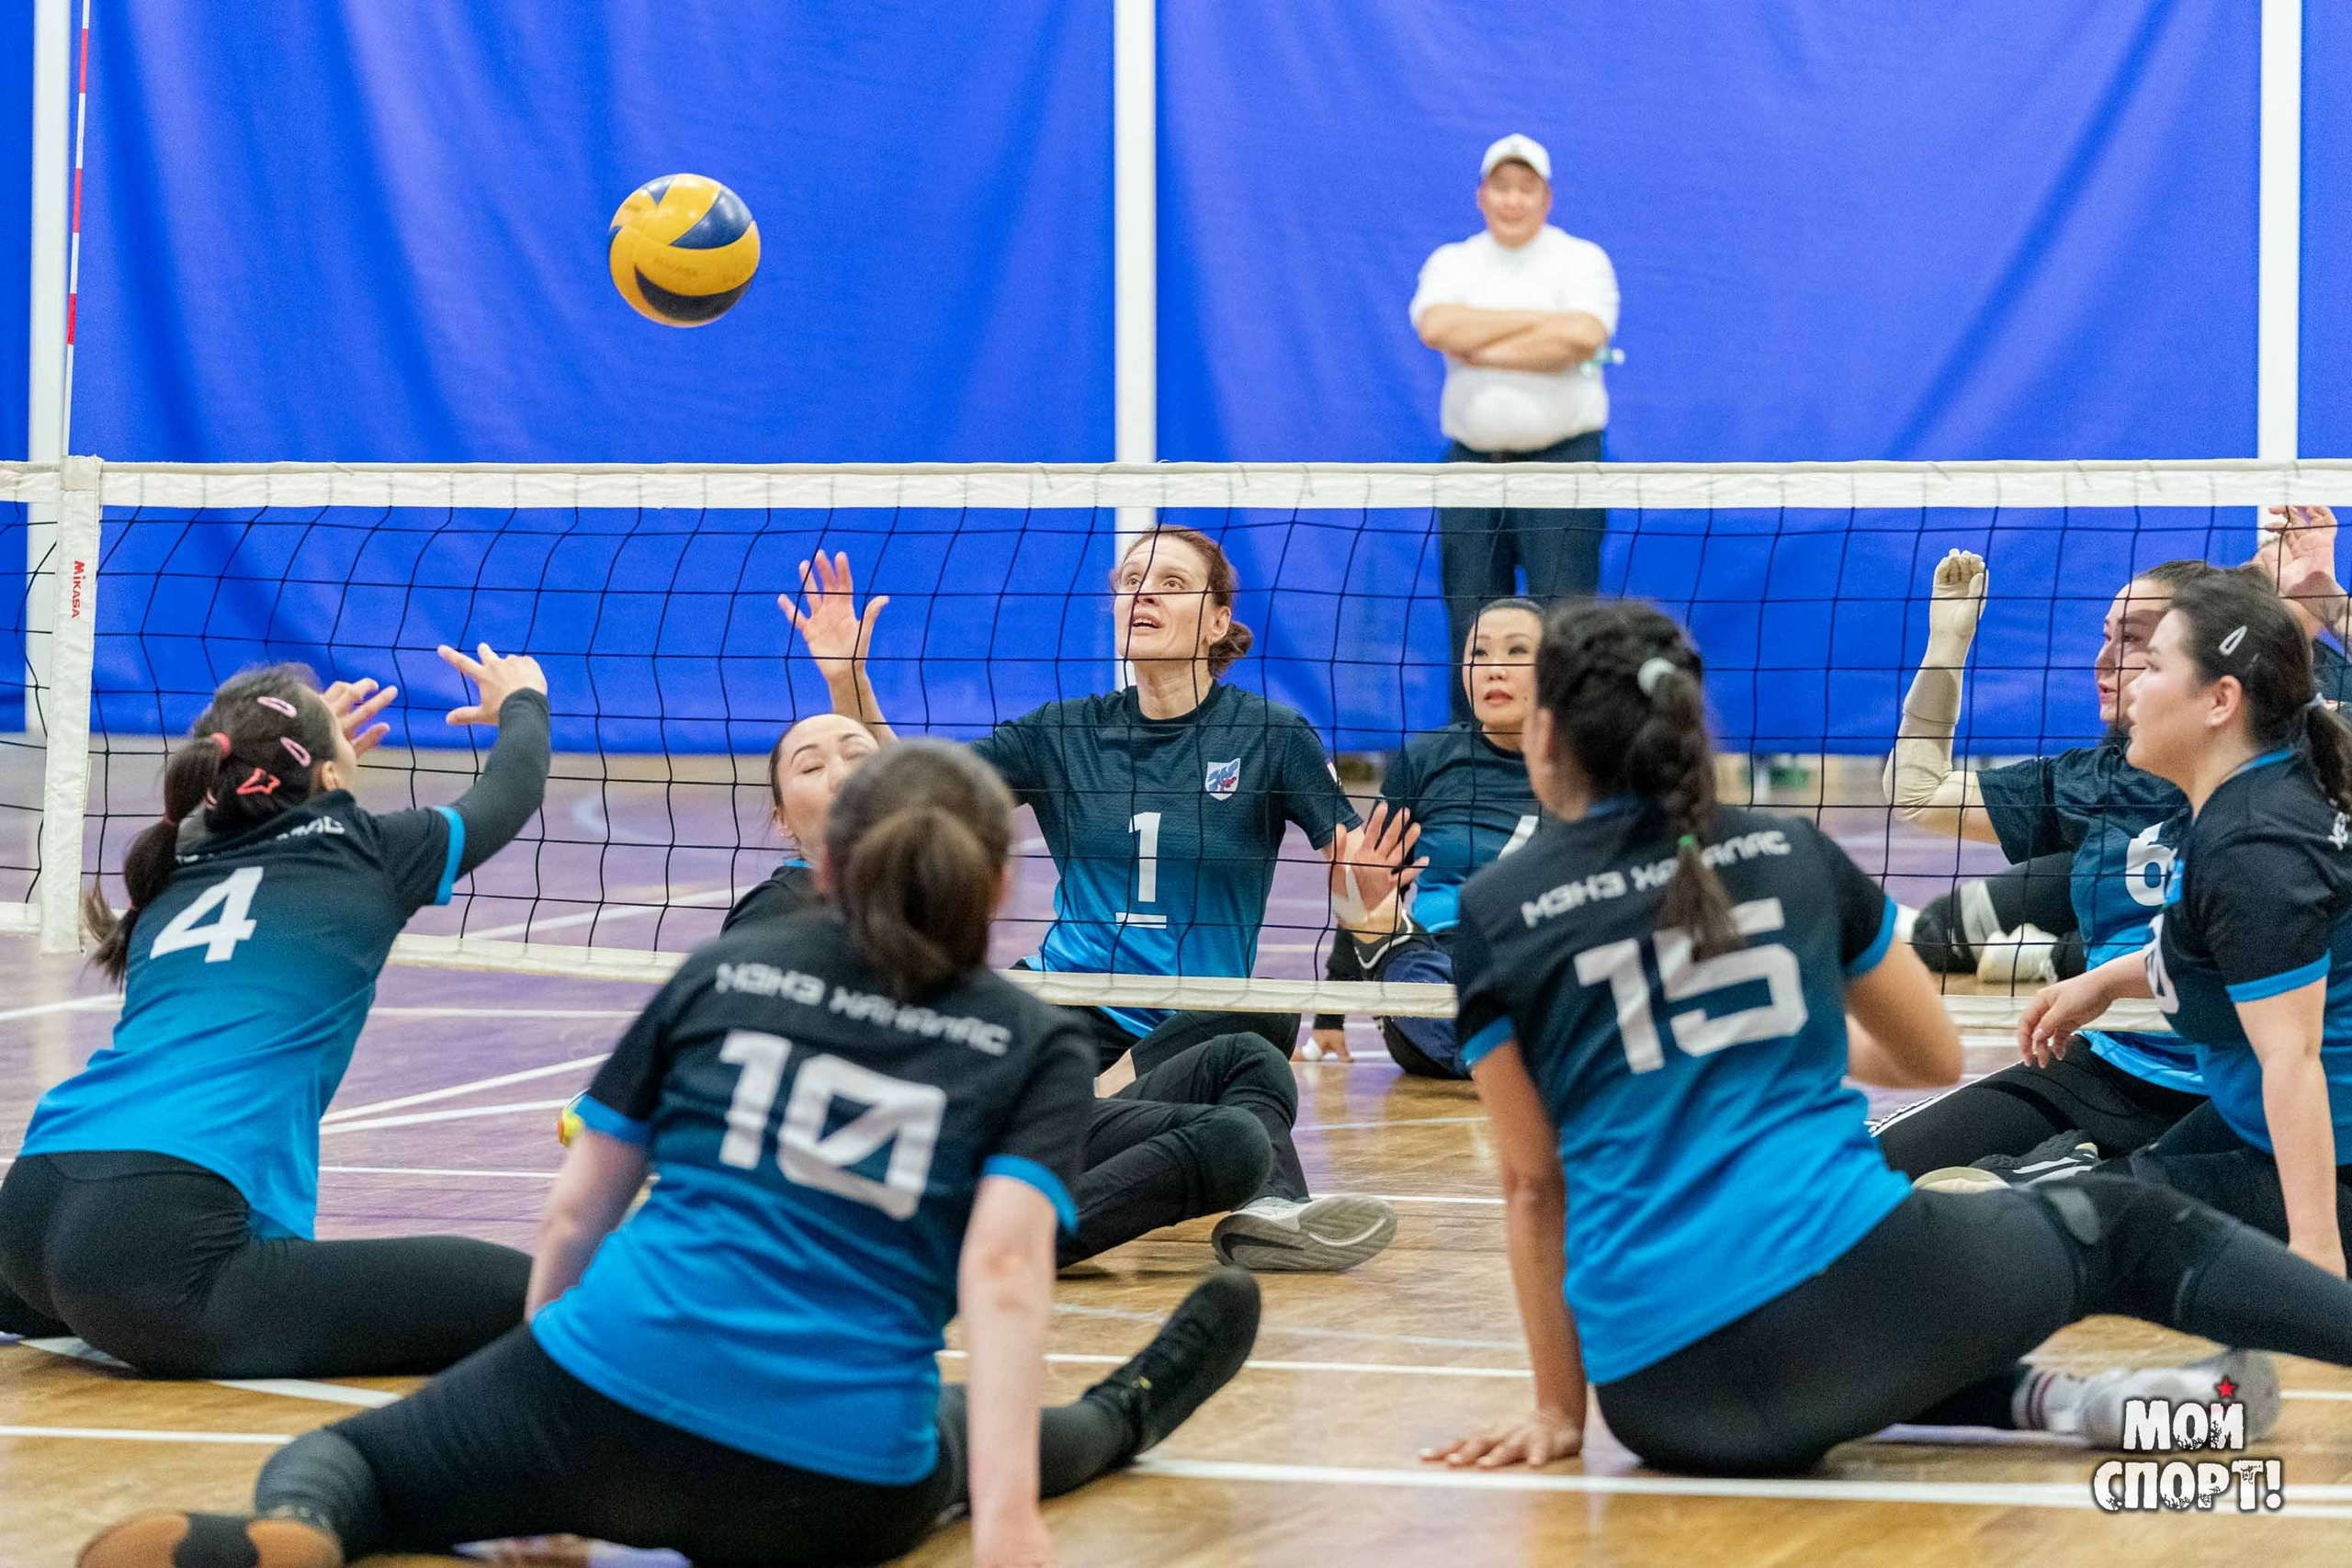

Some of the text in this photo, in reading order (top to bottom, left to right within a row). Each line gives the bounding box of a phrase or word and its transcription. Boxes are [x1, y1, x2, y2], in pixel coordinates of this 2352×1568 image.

[1128, 812, 1162, 903] 1
[2125, 821, 2178, 907] 6
[150, 866, 264, 964] 4
[1573, 897, 1809, 1075] 15
[718, 1029, 947, 1221] 10
